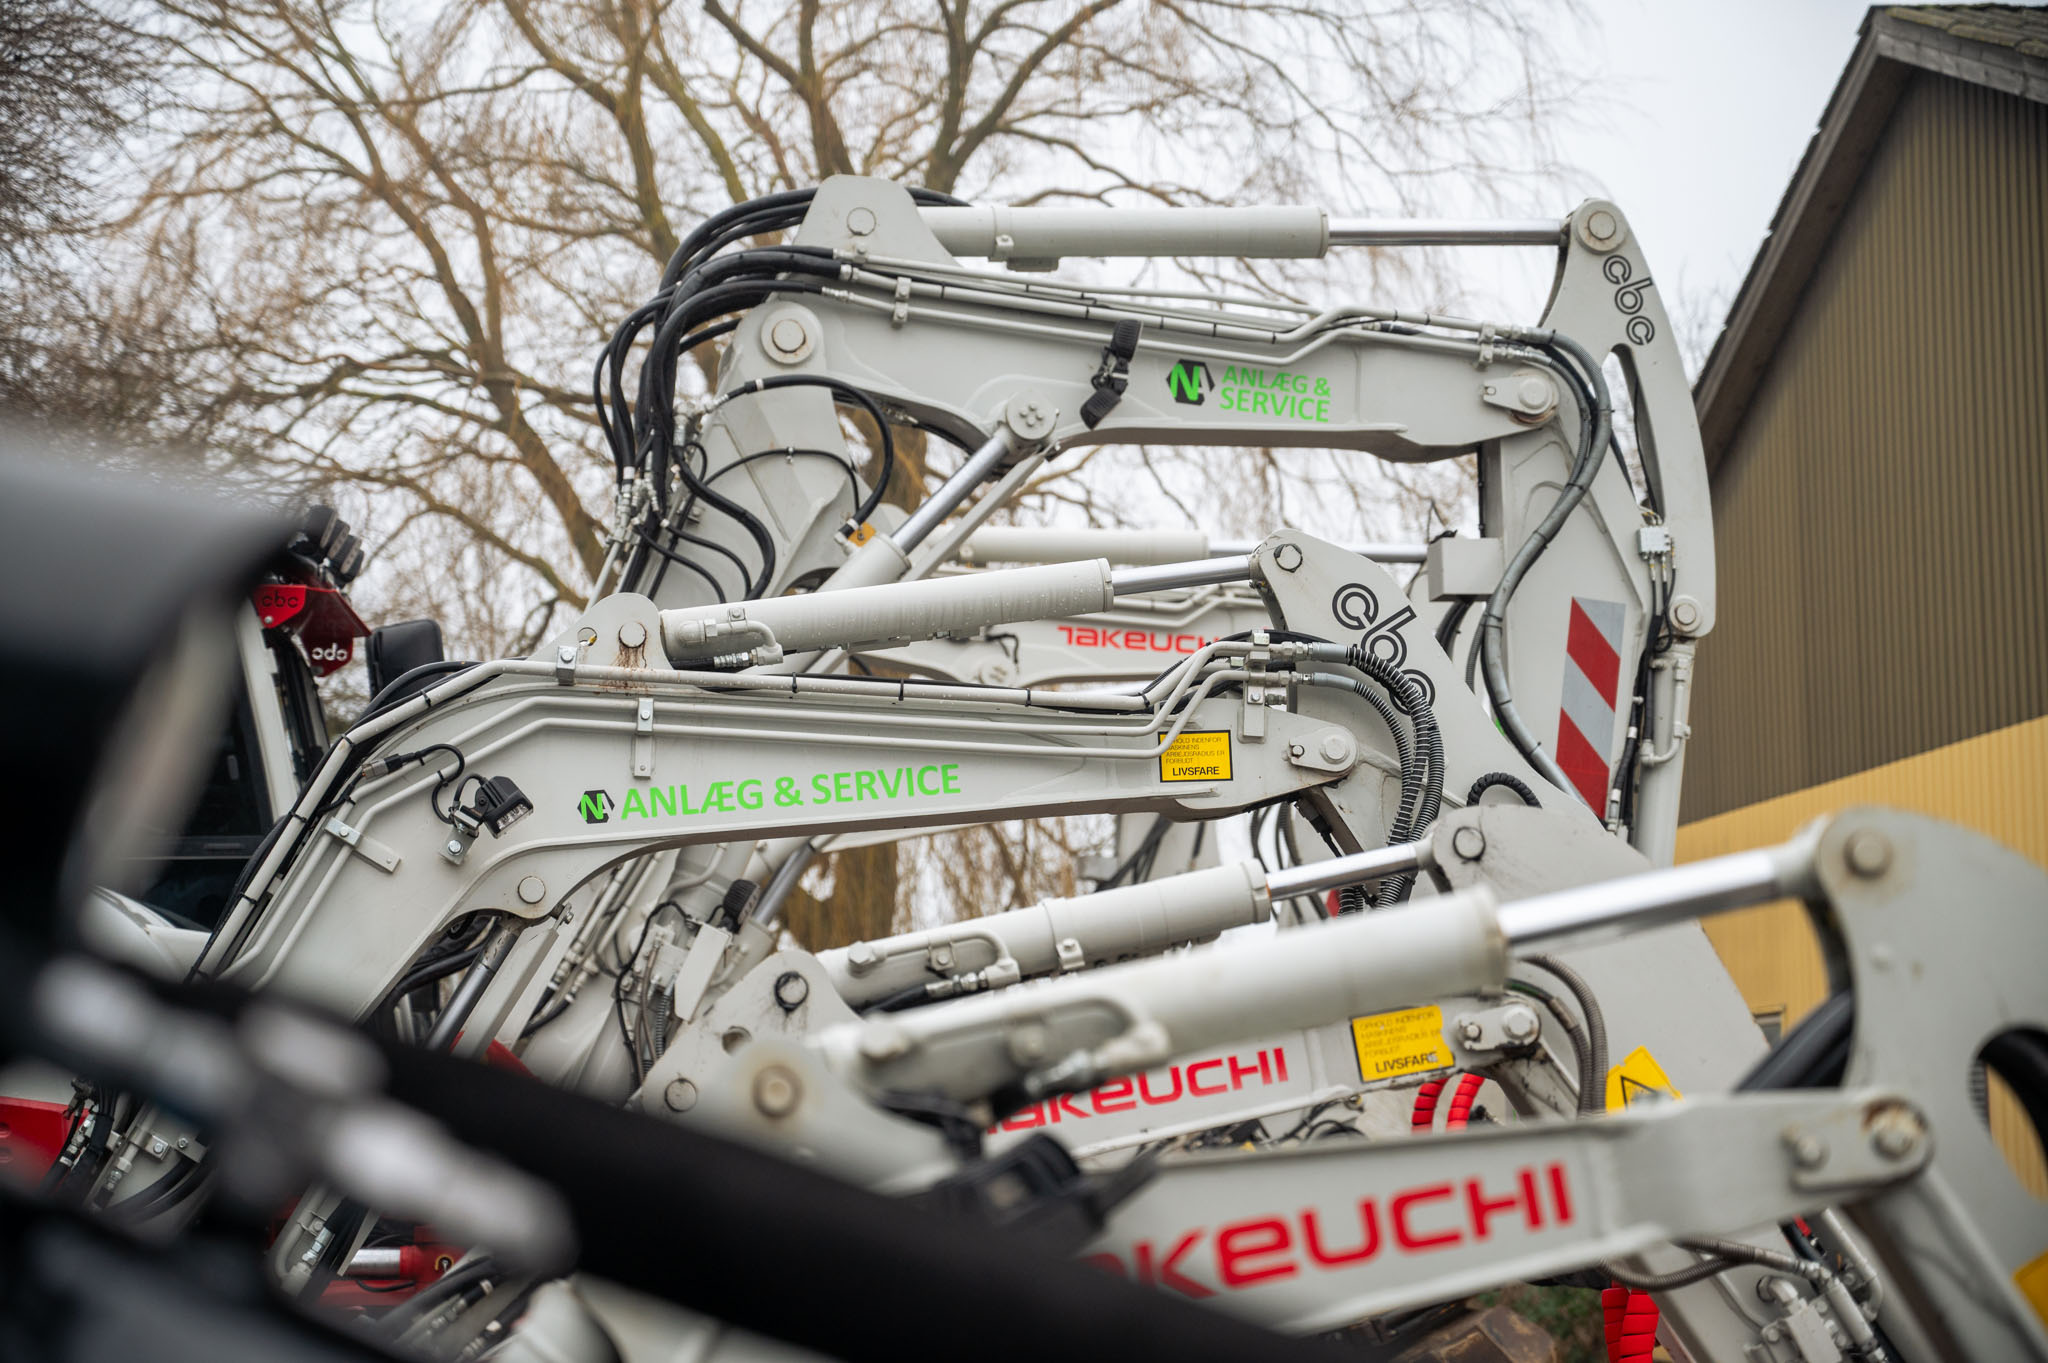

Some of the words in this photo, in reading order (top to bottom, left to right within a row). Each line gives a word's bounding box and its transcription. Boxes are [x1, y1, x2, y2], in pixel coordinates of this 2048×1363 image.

[1603, 255, 1655, 345] cbc
[1221, 364, 1309, 395] ANLÆG
[1313, 376, 1332, 398] &
[1219, 386, 1332, 423] SERVICE
[262, 591, 299, 608] cbc
[1172, 766, 1220, 776] LIVSFARE
[621, 778, 764, 820] ANLÆG
[773, 776, 804, 807] &
[811, 763, 961, 805] SERVICE
